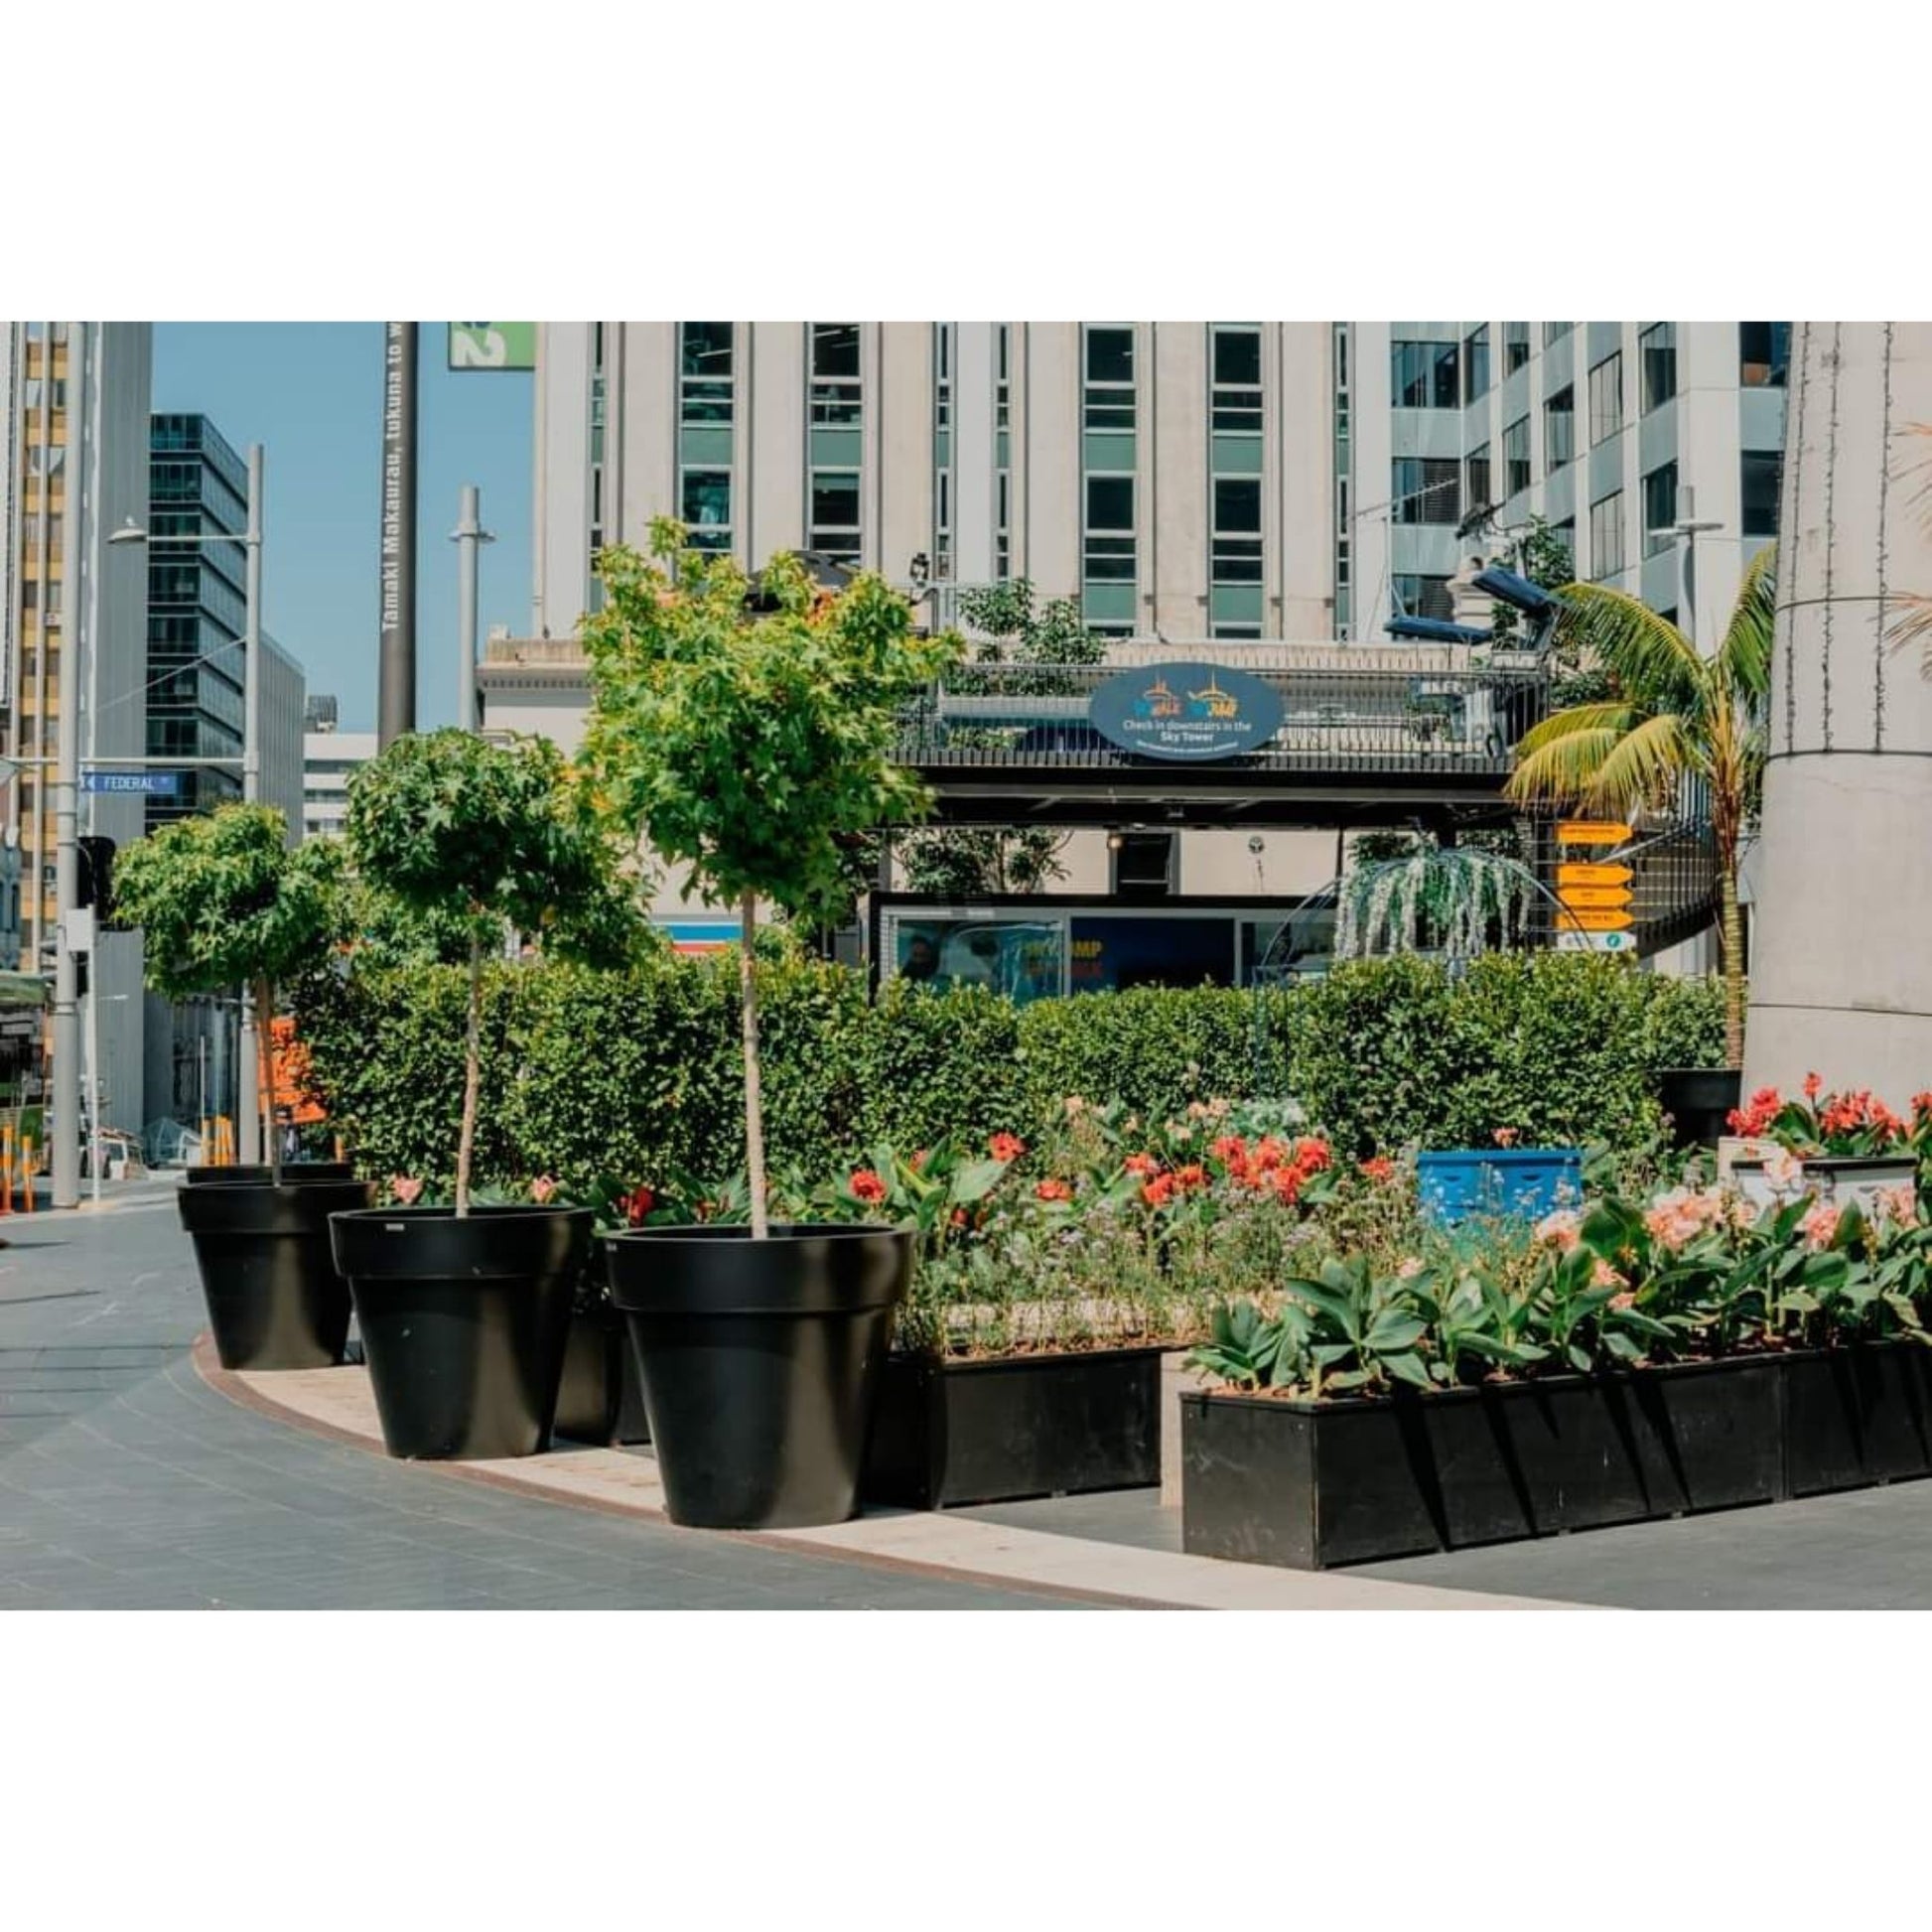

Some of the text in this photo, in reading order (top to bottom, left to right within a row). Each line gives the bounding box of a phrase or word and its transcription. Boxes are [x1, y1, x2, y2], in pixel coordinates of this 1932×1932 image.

[387, 345, 402, 365] to
[386, 370, 402, 440] tukuna
[1123, 720, 1252, 732] Check in downstairs in the
[1161, 731, 1214, 743] Sky Tower
[104, 776, 155, 790] FEDERAL
